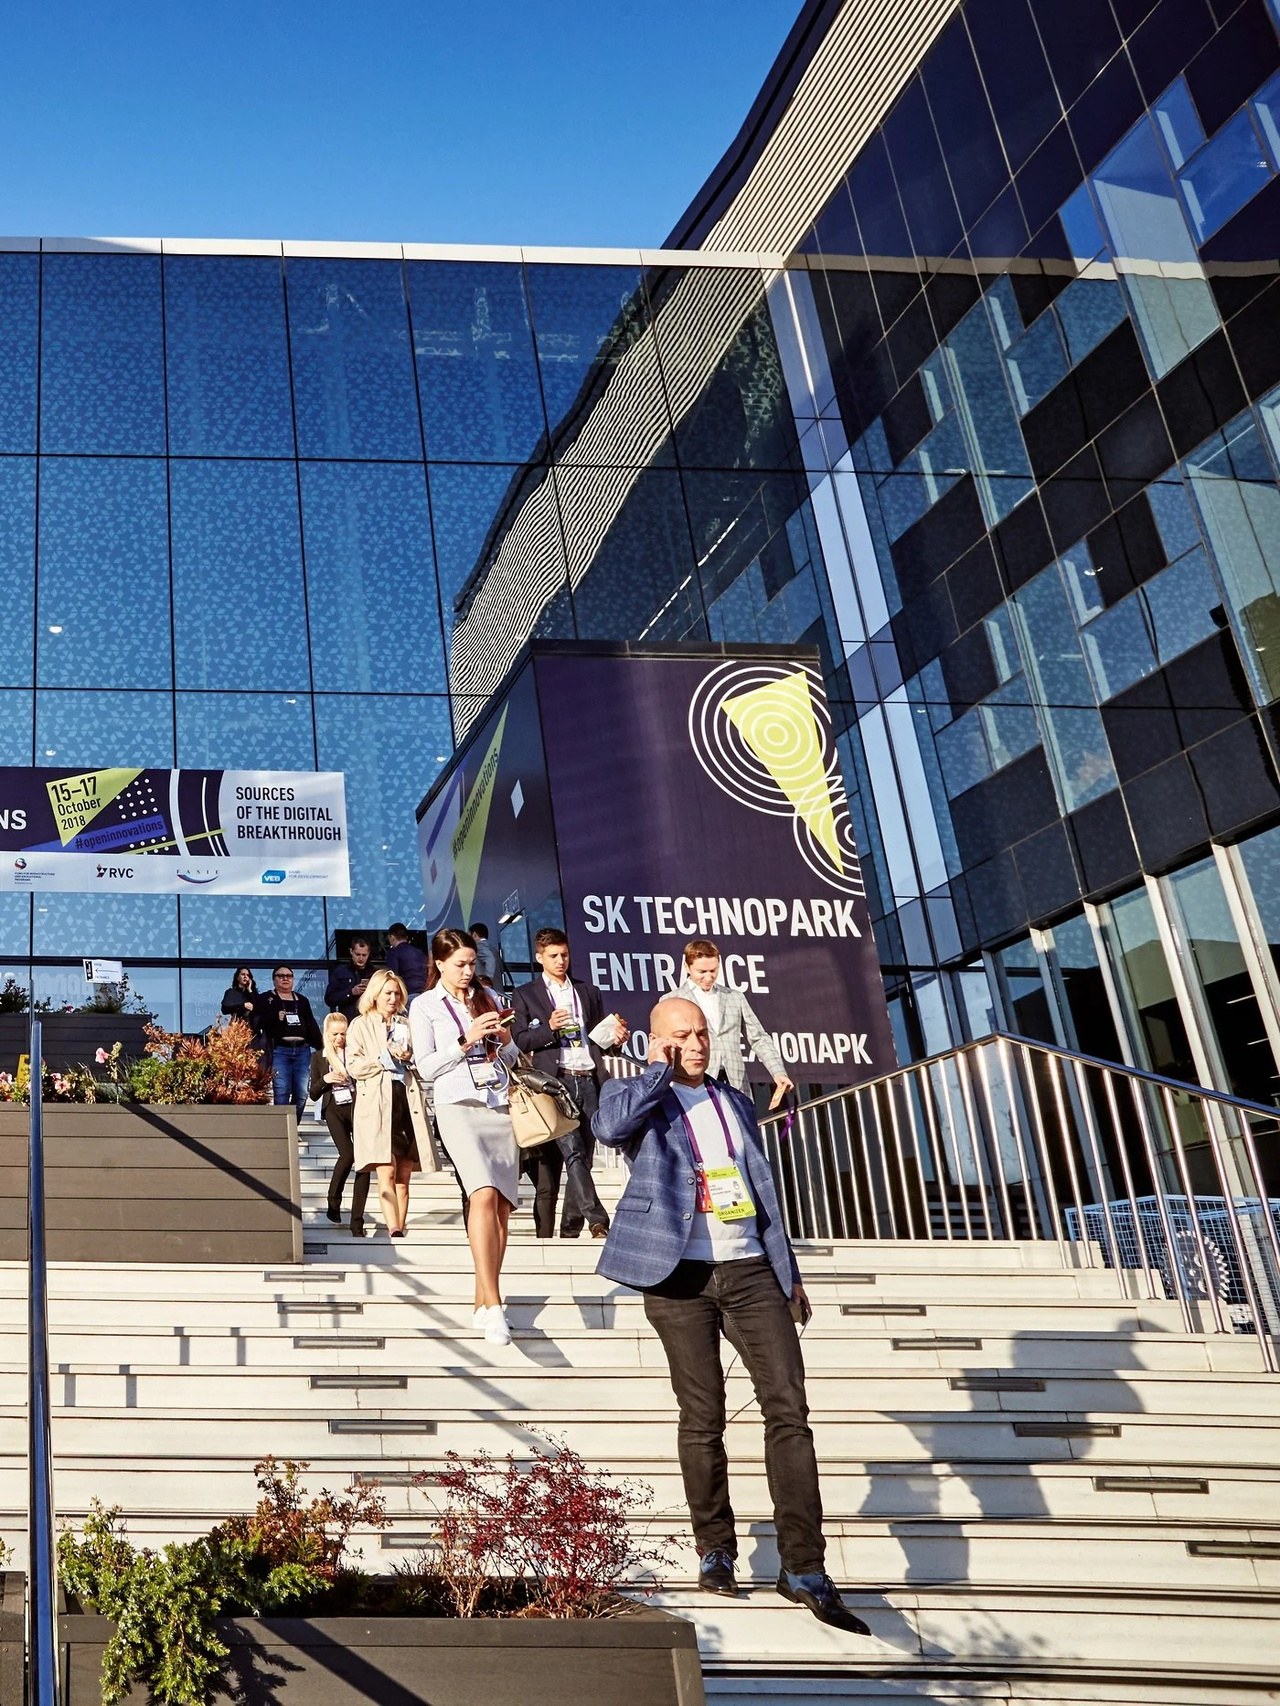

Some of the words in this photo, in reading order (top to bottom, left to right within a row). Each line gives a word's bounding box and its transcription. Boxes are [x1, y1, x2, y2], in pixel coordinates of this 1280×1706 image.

[51, 775, 97, 803] 15–17
[235, 786, 295, 801] SOURCES
[57, 797, 101, 816] October
[236, 805, 253, 820] OF
[256, 806, 280, 820] THE
[283, 806, 333, 821] DIGITAL
[452, 746, 500, 862] #openinnovations
[61, 815, 86, 831] 2018
[237, 824, 342, 841] BREAKTHROUGH
[75, 820, 164, 850] #openinnovations
[109, 867, 134, 879] RVC
[582, 894, 626, 934] SK
[634, 895, 862, 938] TECHNOPARK
[739, 1032, 873, 1065] ОПАРК
